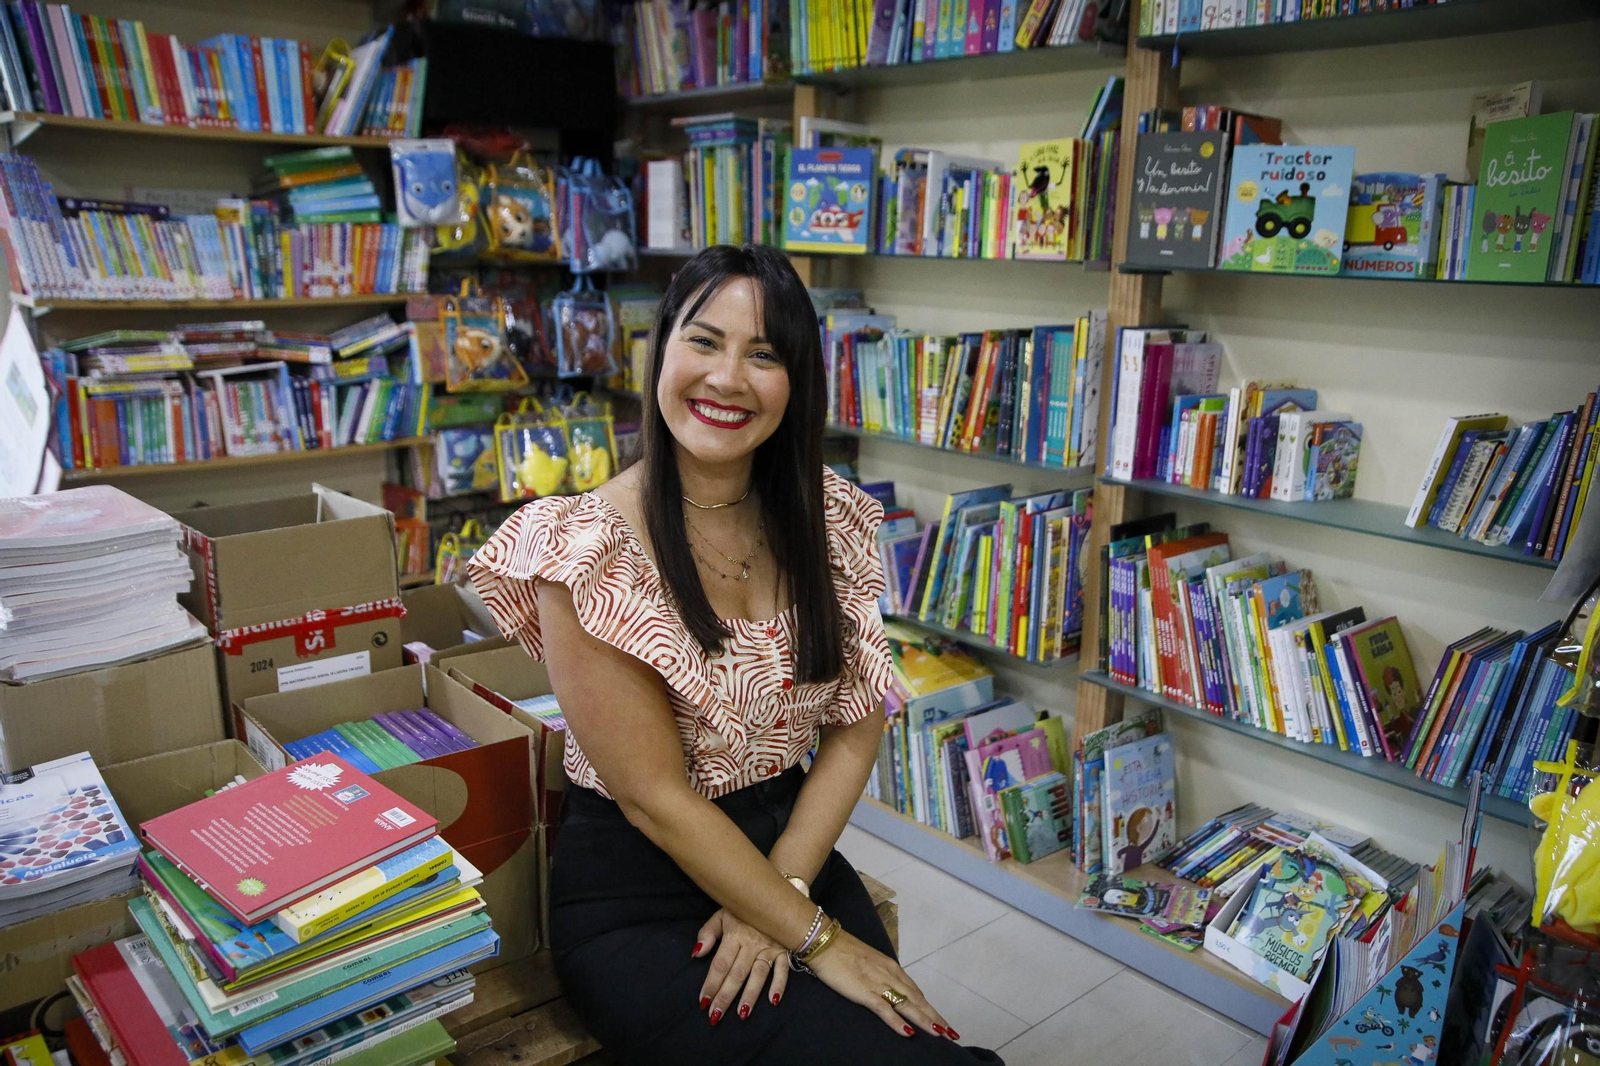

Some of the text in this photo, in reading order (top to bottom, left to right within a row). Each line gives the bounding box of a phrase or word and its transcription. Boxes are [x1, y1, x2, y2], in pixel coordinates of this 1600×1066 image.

[1266, 150, 1333, 165] Tractor
[807, 163, 836, 173] PLANETA
[838, 164, 861, 173] TIERRA
[1260, 167, 1326, 181] ruidoso
[1486, 148, 1553, 187] besito
[1344, 257, 1414, 273] NÚMEROS
[250, 658, 274, 673] 2024
[23, 851, 97, 878] Andalucía
[1264, 935, 1304, 966] MÚSICOS
